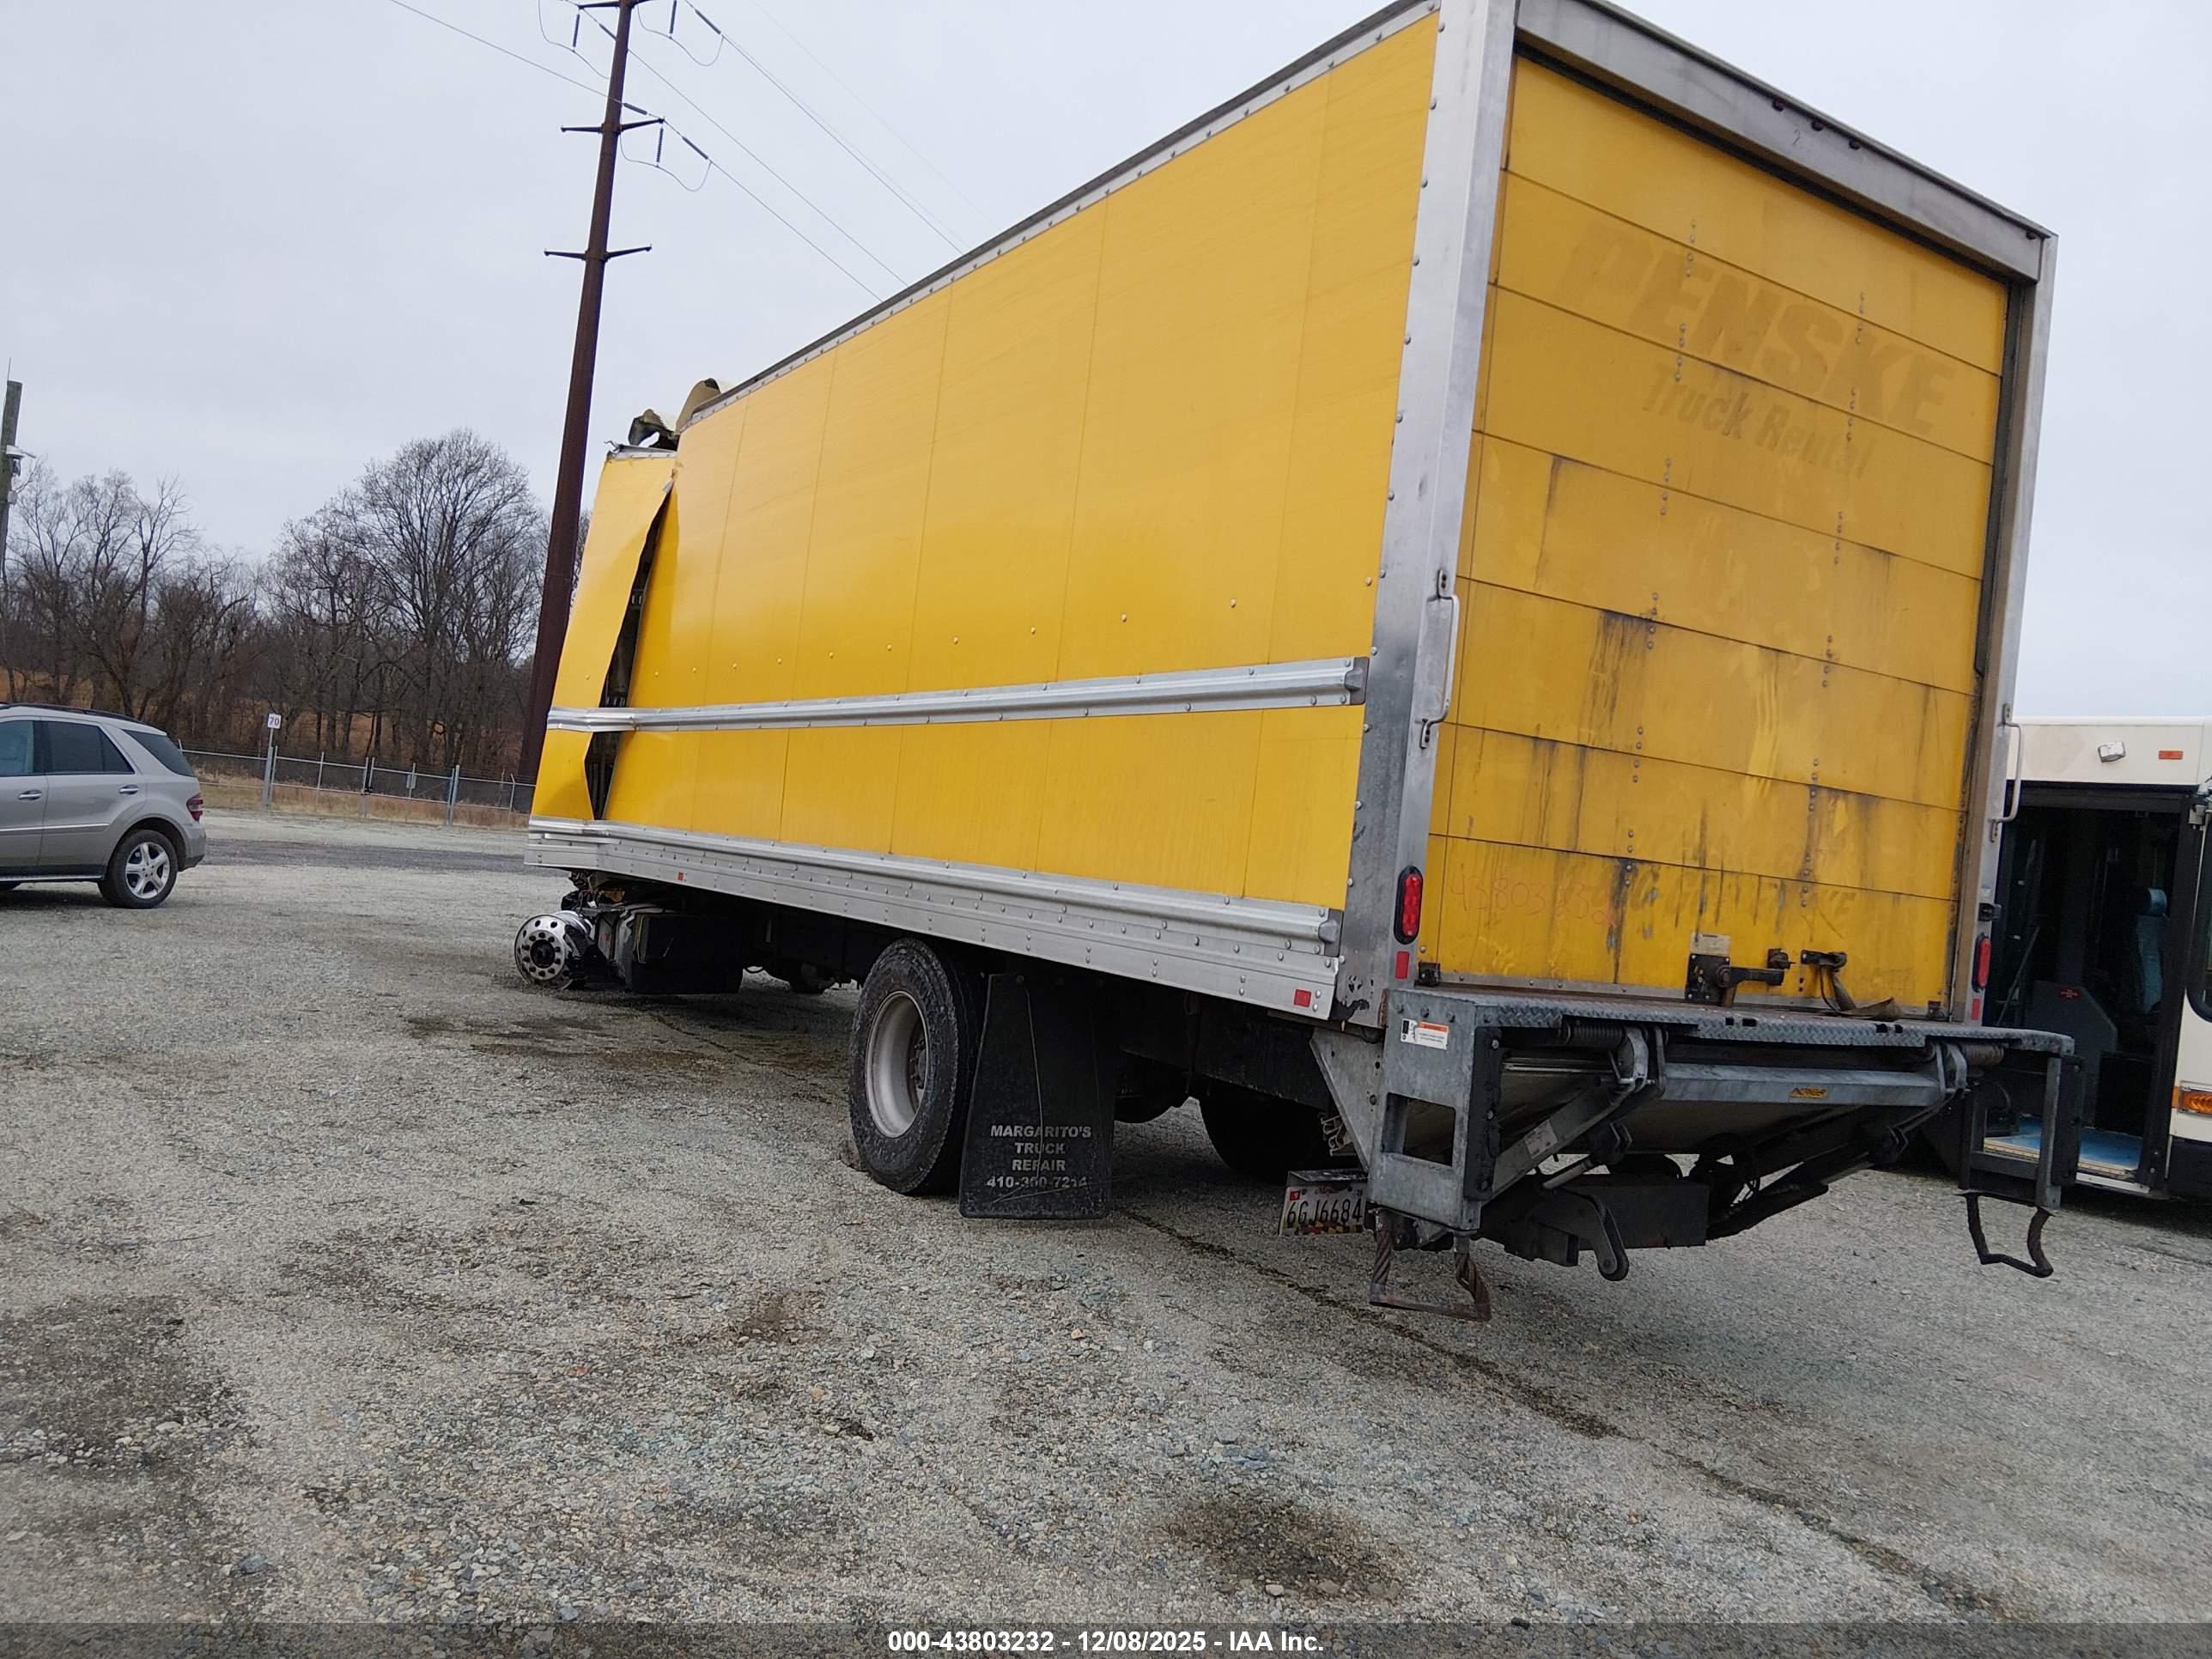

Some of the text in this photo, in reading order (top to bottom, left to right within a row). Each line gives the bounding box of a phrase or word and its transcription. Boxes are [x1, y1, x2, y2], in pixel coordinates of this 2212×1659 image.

[1552, 220, 1956, 435] PENSKE
[1642, 362, 1878, 481] Truck Rental
[269, 717, 280, 726] 70
[990, 1124, 1092, 1139] MARGARITO'S
[1014, 1142, 1066, 1155] TRUCK
[1012, 1159, 1066, 1171] REPAIR
